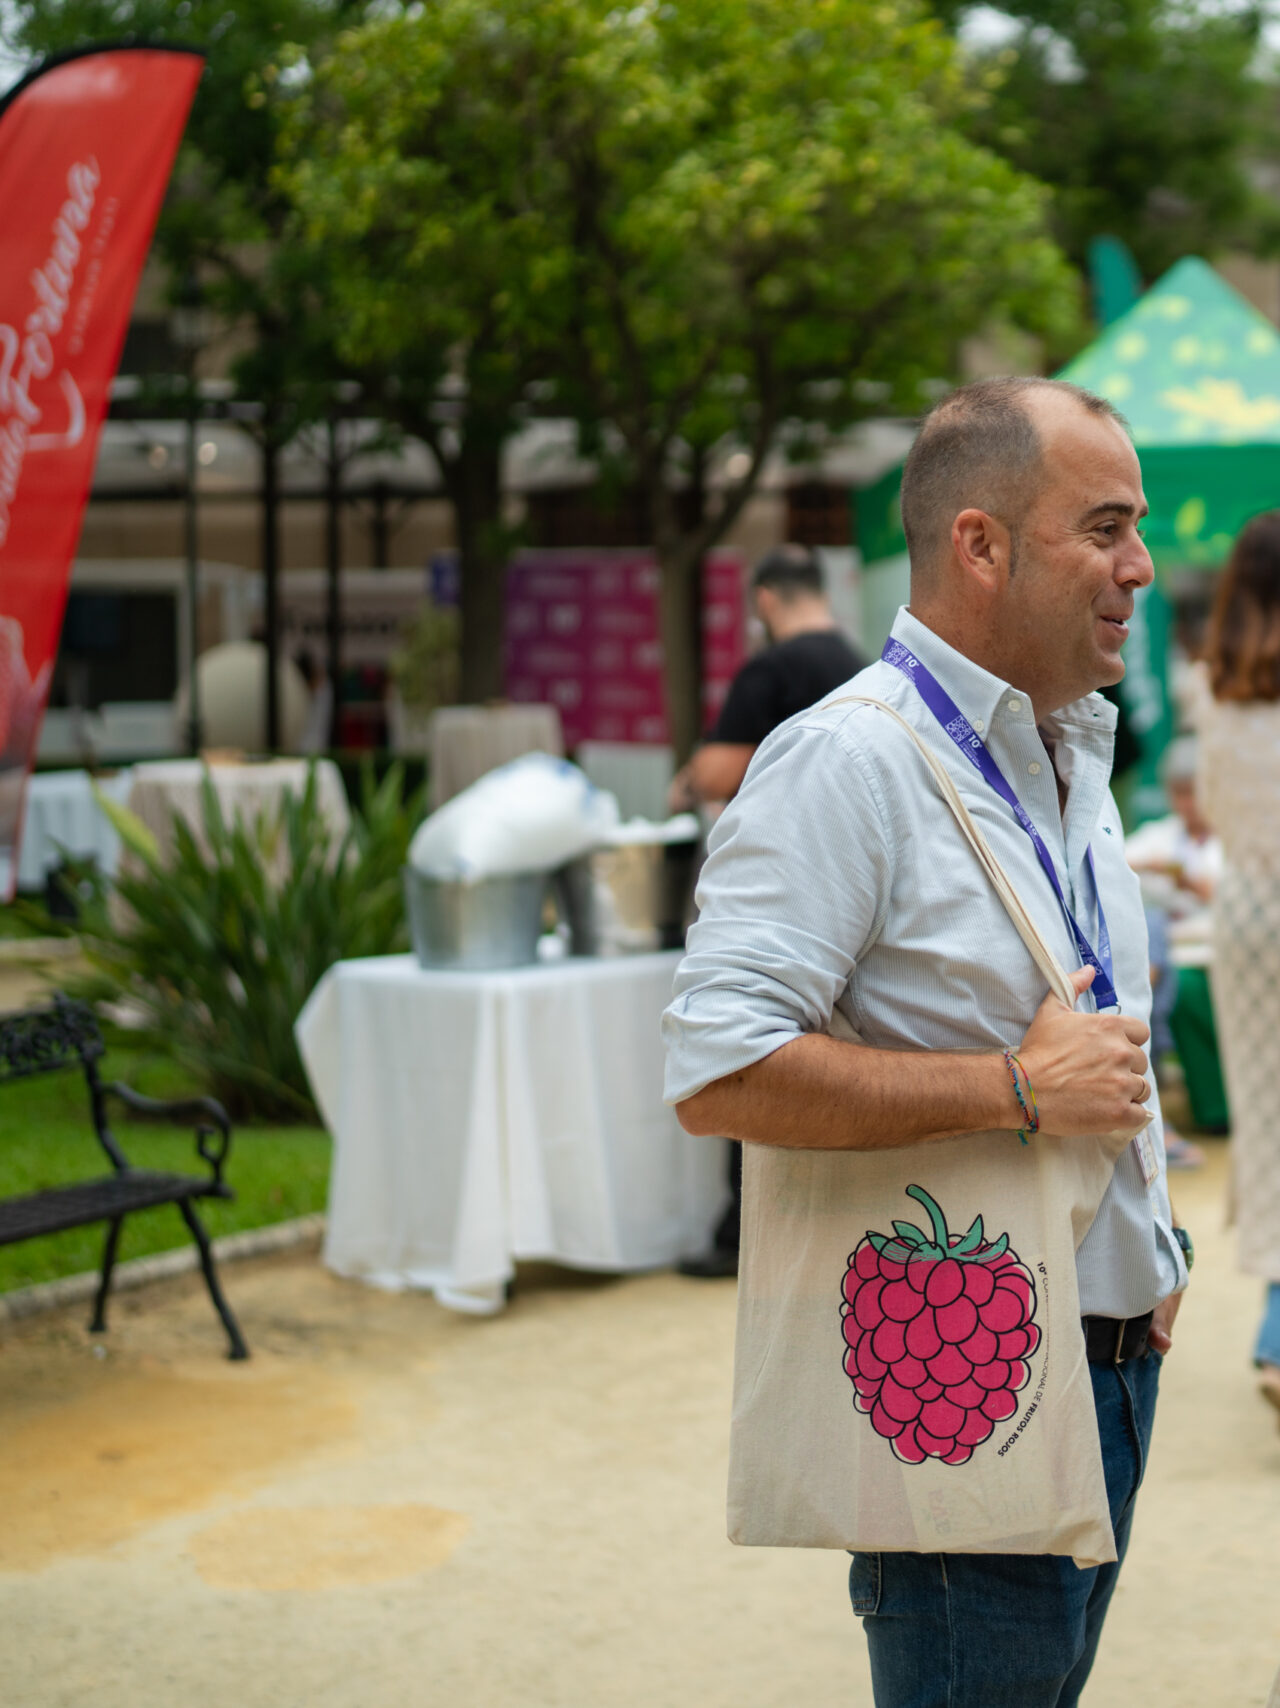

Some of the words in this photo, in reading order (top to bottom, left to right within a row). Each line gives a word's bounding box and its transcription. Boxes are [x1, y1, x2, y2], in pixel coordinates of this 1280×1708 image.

[1034, 1391, 1043, 1402] DE
[1016, 1402, 1038, 1433] FRUTOS
[997, 1431, 1019, 1457] ROJOS
